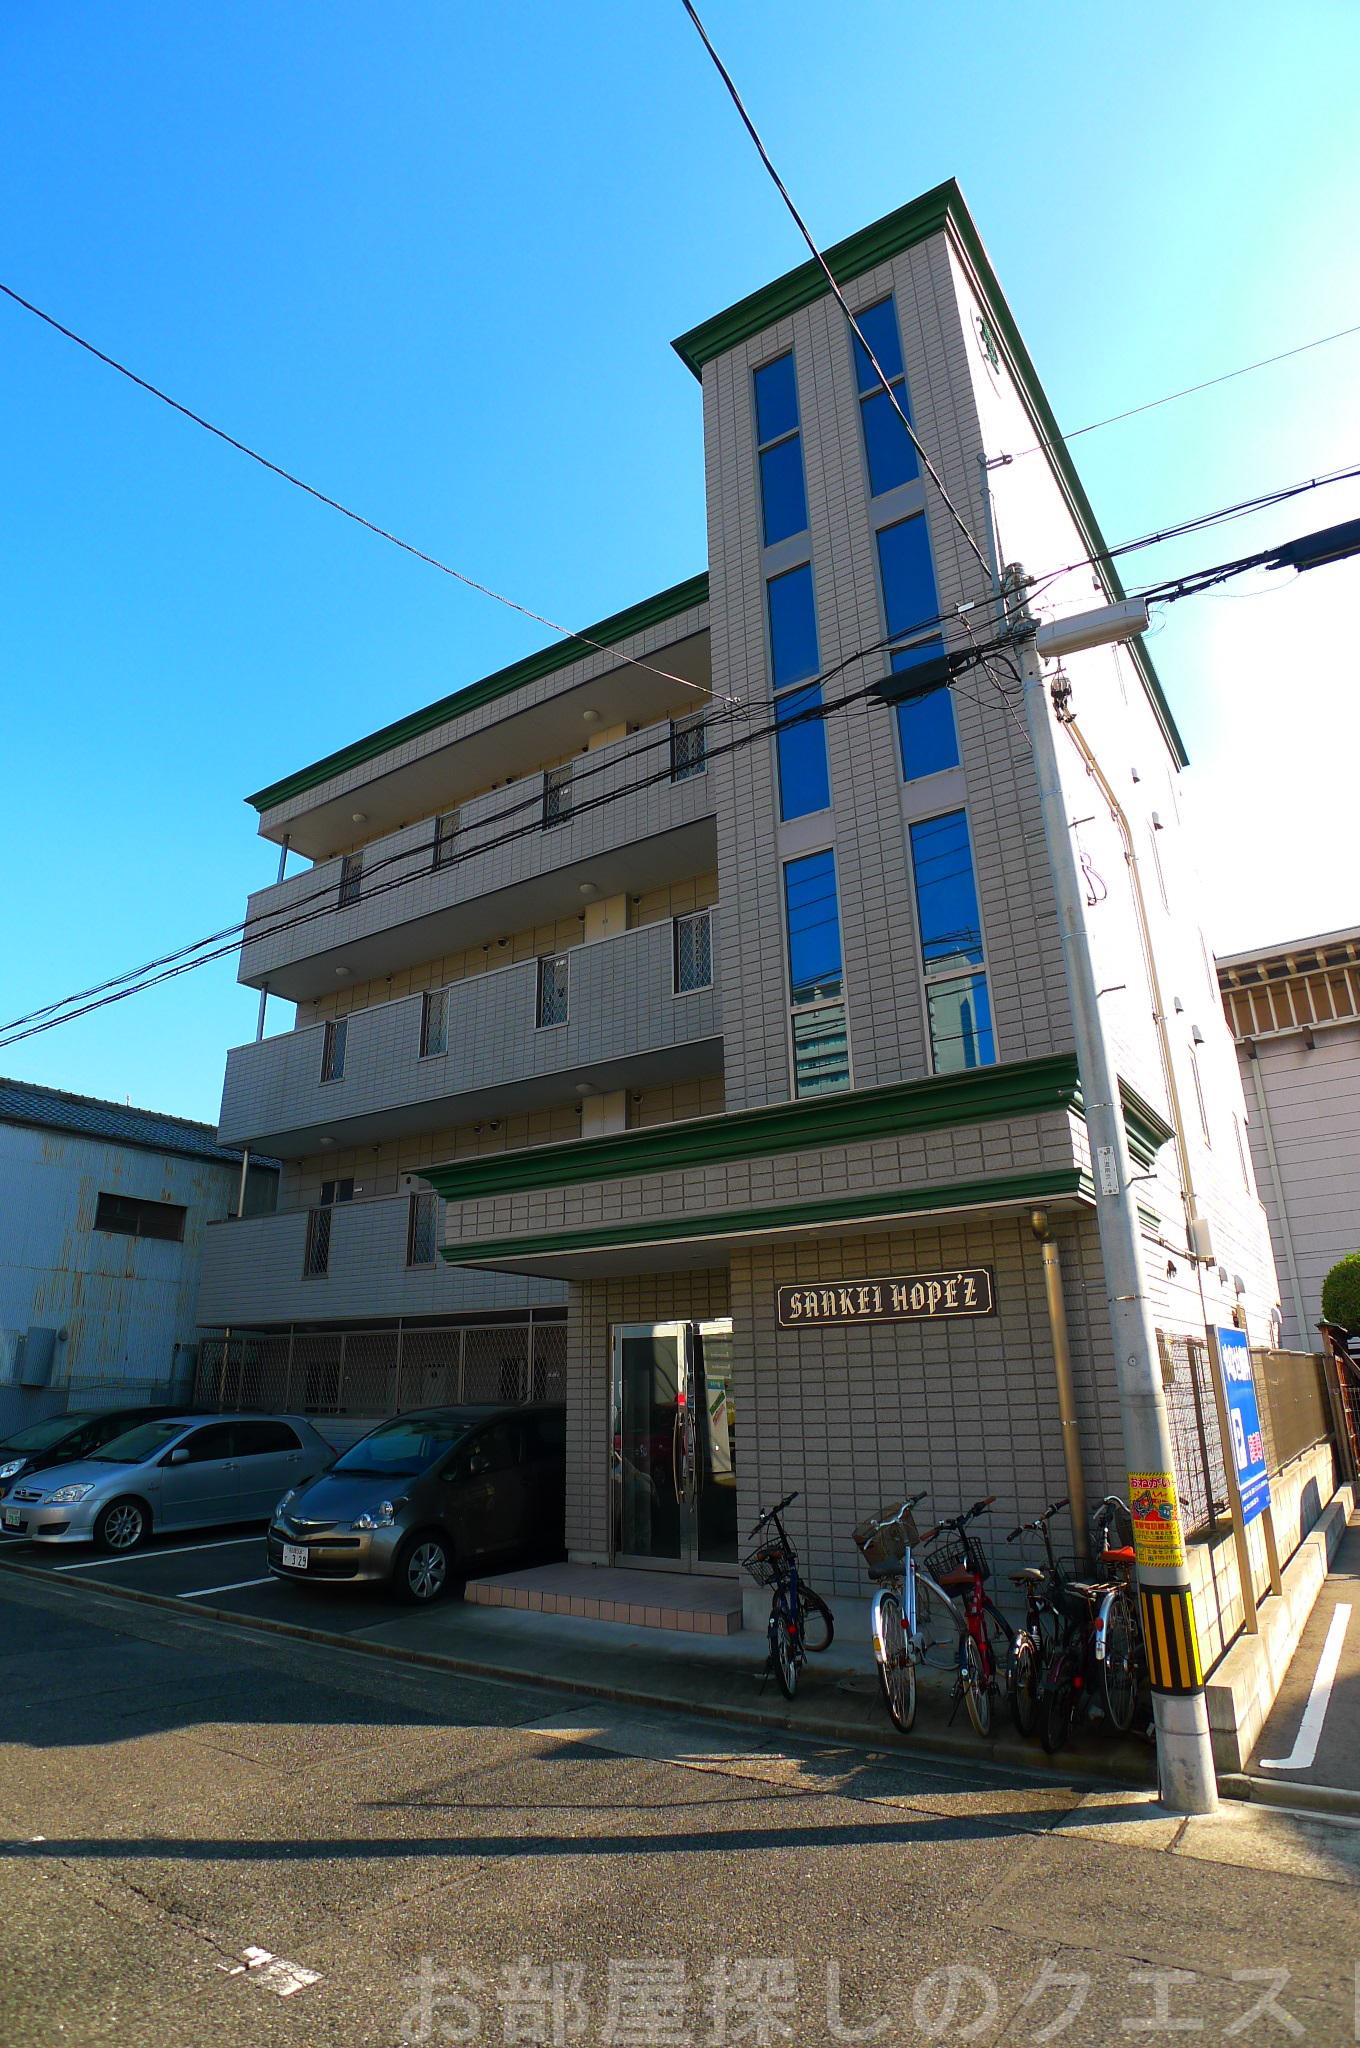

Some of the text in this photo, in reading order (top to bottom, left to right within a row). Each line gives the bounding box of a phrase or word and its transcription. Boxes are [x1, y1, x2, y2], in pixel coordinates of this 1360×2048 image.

[788, 1285, 884, 1319] SANKEI
[1130, 1477, 1171, 1489] おねがい
